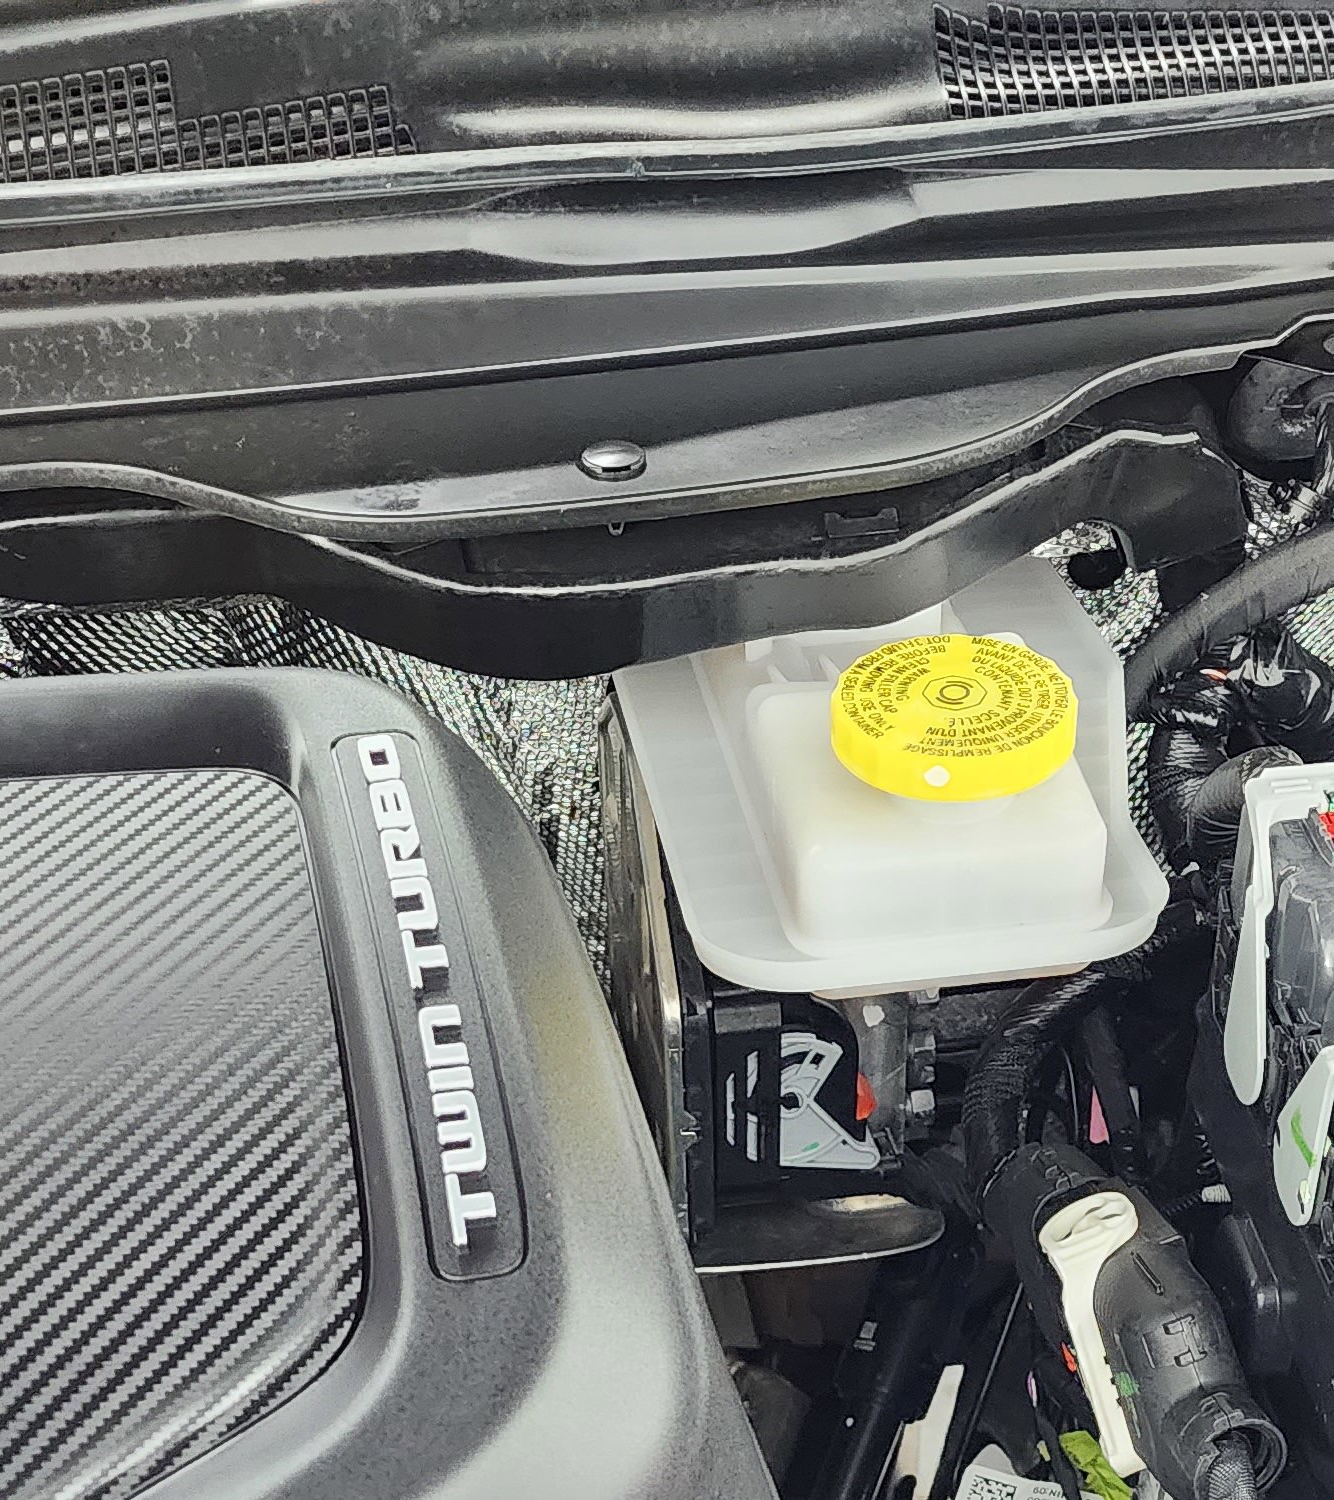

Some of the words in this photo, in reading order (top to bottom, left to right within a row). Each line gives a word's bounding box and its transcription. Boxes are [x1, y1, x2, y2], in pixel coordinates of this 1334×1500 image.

[914, 638, 923, 646] 3
[927, 635, 950, 644] DOT
[971, 637, 1000, 648] MISE
[881, 641, 914, 655] FLUID
[896, 645, 945, 660] BEFORE
[976, 648, 1015, 662] AVANT
[1001, 643, 1019, 653] EN
[855, 652, 883, 670] FROM
[892, 658, 929, 674] CLEAN
[972, 656, 991, 664] DU
[1012, 660, 1030, 671] DE
[990, 662, 1028, 686] LIQUIDE
[1024, 670, 1041, 679] LE
[841, 676, 859, 700] SEALED
[877, 674, 898, 697] FILLER
[975, 666, 1013, 710] CONTENANT
[1048, 673, 1068, 708] NETTOYER
[1018, 688, 1032, 702] DOT
[860, 698, 877, 711] USE
[879, 699, 897, 713] CAP
[844, 703, 883, 738] CONTAINER
[1049, 709, 1065, 718] LE
[869, 713, 894, 730] ONLY
[962, 708, 1026, 737] PROVENANT
[1004, 712, 1043, 737] UTILISER
[1012, 719, 1058, 746] BOUCHON
[920, 734, 1003, 747] UNIQUEMENT
[995, 743, 1012, 752] DE
[904, 744, 991, 756] REMPLISSAGE
[356, 734, 449, 988] TURBO
[418, 1004, 497, 1247] TWIN
